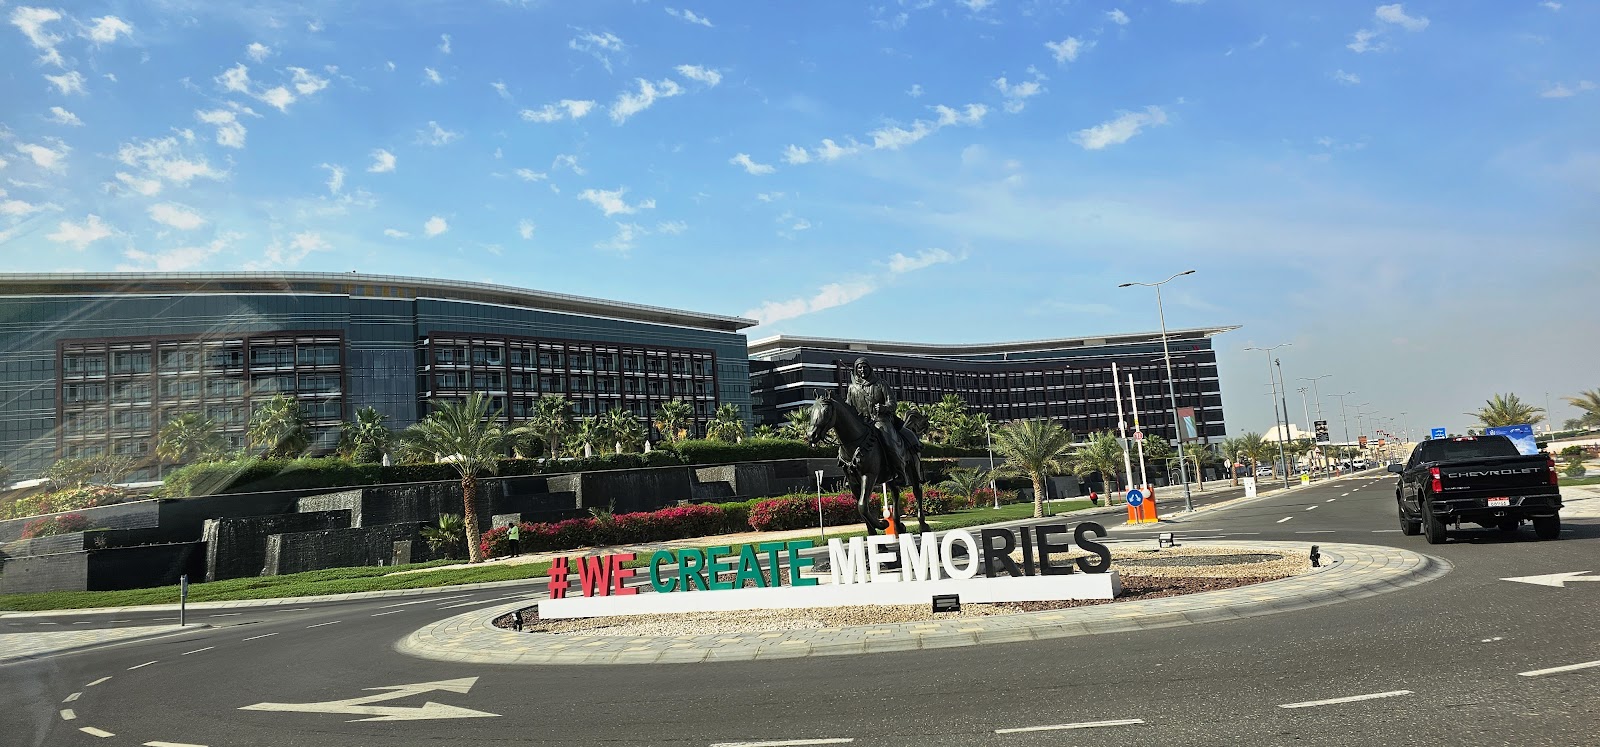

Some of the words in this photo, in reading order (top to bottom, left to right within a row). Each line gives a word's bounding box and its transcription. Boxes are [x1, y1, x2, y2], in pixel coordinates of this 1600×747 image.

[1448, 467, 1541, 479] CHEVROLET
[650, 539, 819, 594] CREATE
[828, 520, 1112, 585] MEMORIES
